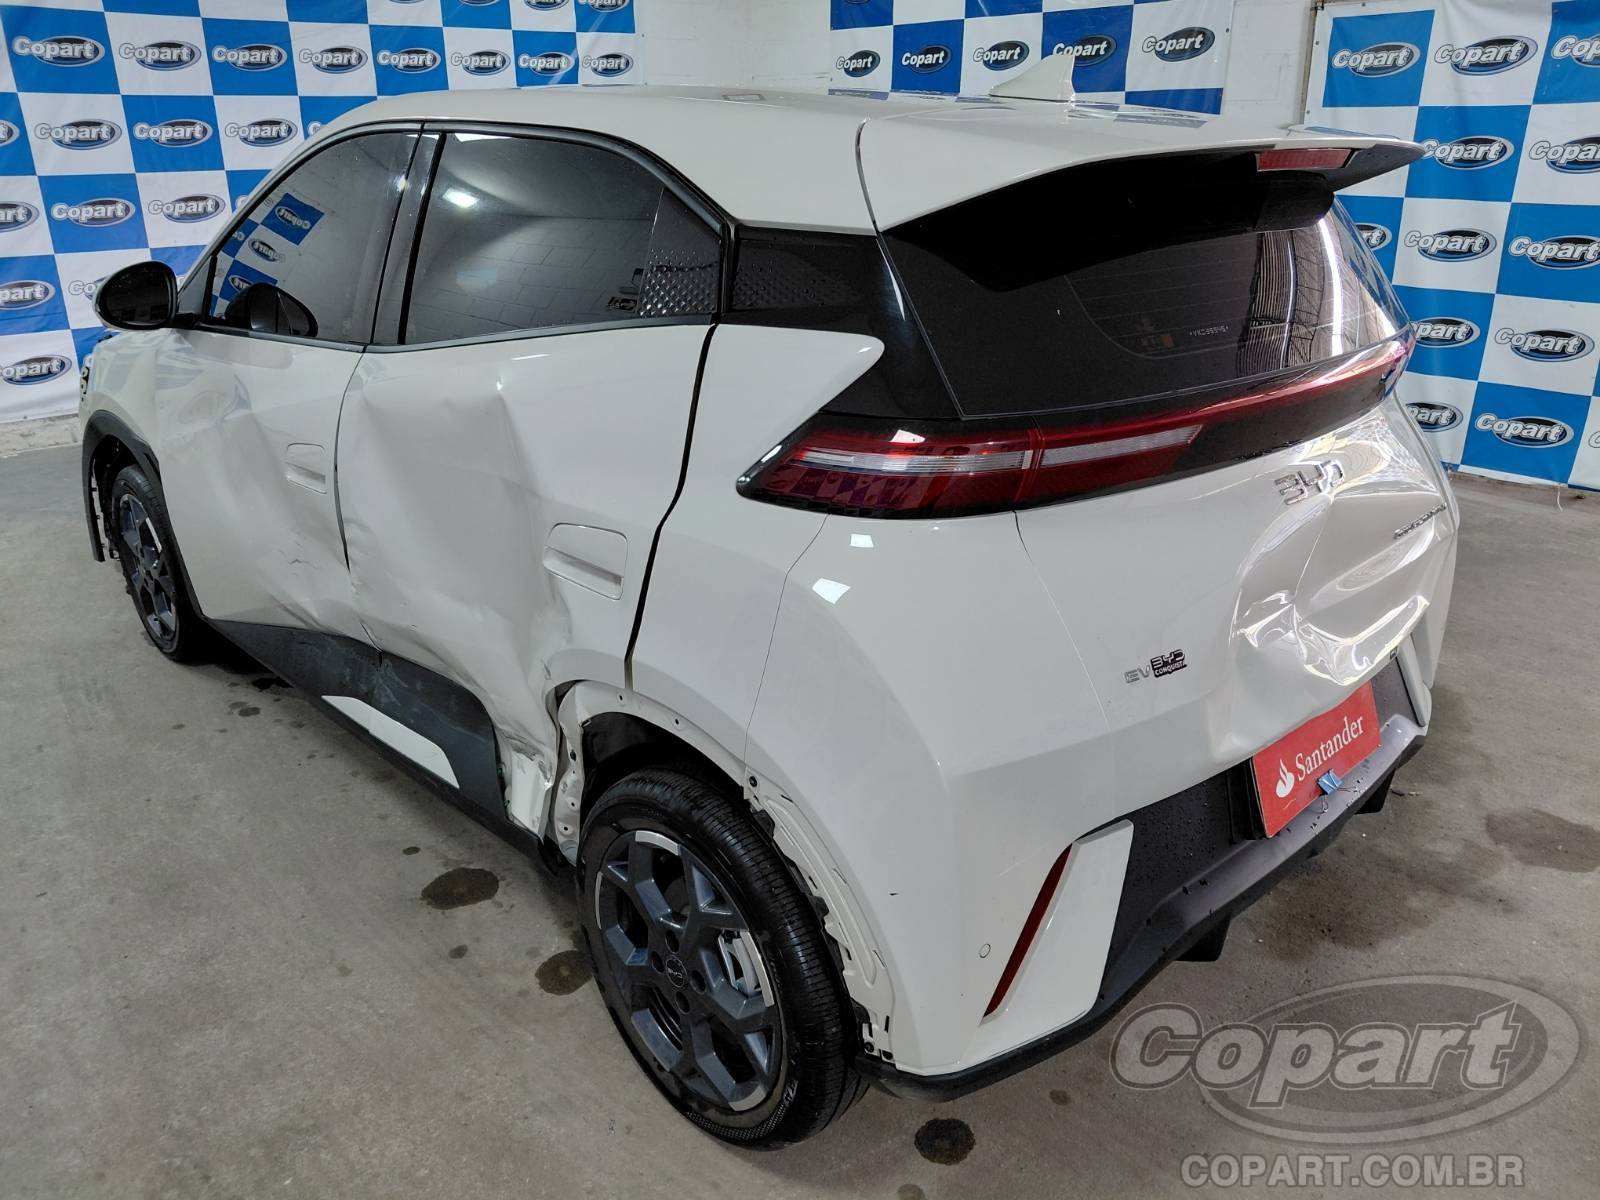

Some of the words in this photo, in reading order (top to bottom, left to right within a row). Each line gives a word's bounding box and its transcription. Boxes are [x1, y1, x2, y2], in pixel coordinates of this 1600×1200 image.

[13, 37, 96, 58] Copart
[1052, 40, 1107, 56] Copart
[1142, 32, 1204, 54] Copart
[119, 42, 190, 64] Copart
[212, 45, 278, 63] Copart
[300, 48, 359, 66] Copart
[377, 50, 433, 67] Copart
[451, 51, 503, 68] Copart
[518, 53, 568, 70] Copart
[582, 54, 627, 70] Copart
[836, 54, 874, 71] Copart
[902, 49, 945, 67] Copart
[973, 46, 1020, 64] Copart
[1332, 46, 1413, 71] Copart
[1434, 41, 1526, 65] Copart
[34, 122, 112, 144] Copart
[133, 121, 203, 141] Copart
[225, 121, 289, 140] Copart
[1529, 140, 1600, 166] Copa
[52, 201, 126, 220] Copart
[148, 199, 215, 218] Copart
[1404, 231, 1488, 254] Copart
[1510, 236, 1600, 263] Copart
[0, 283, 45, 304] part
[1409, 322, 1470, 341] part
[1495, 328, 1582, 354] Copart
[0, 358, 61, 381] opart
[1475, 412, 1564, 441] Copart
[1151, 650, 1185, 669] BYD
[1125, 665, 1151, 683] EV
[1295, 715, 1364, 781] Santander
